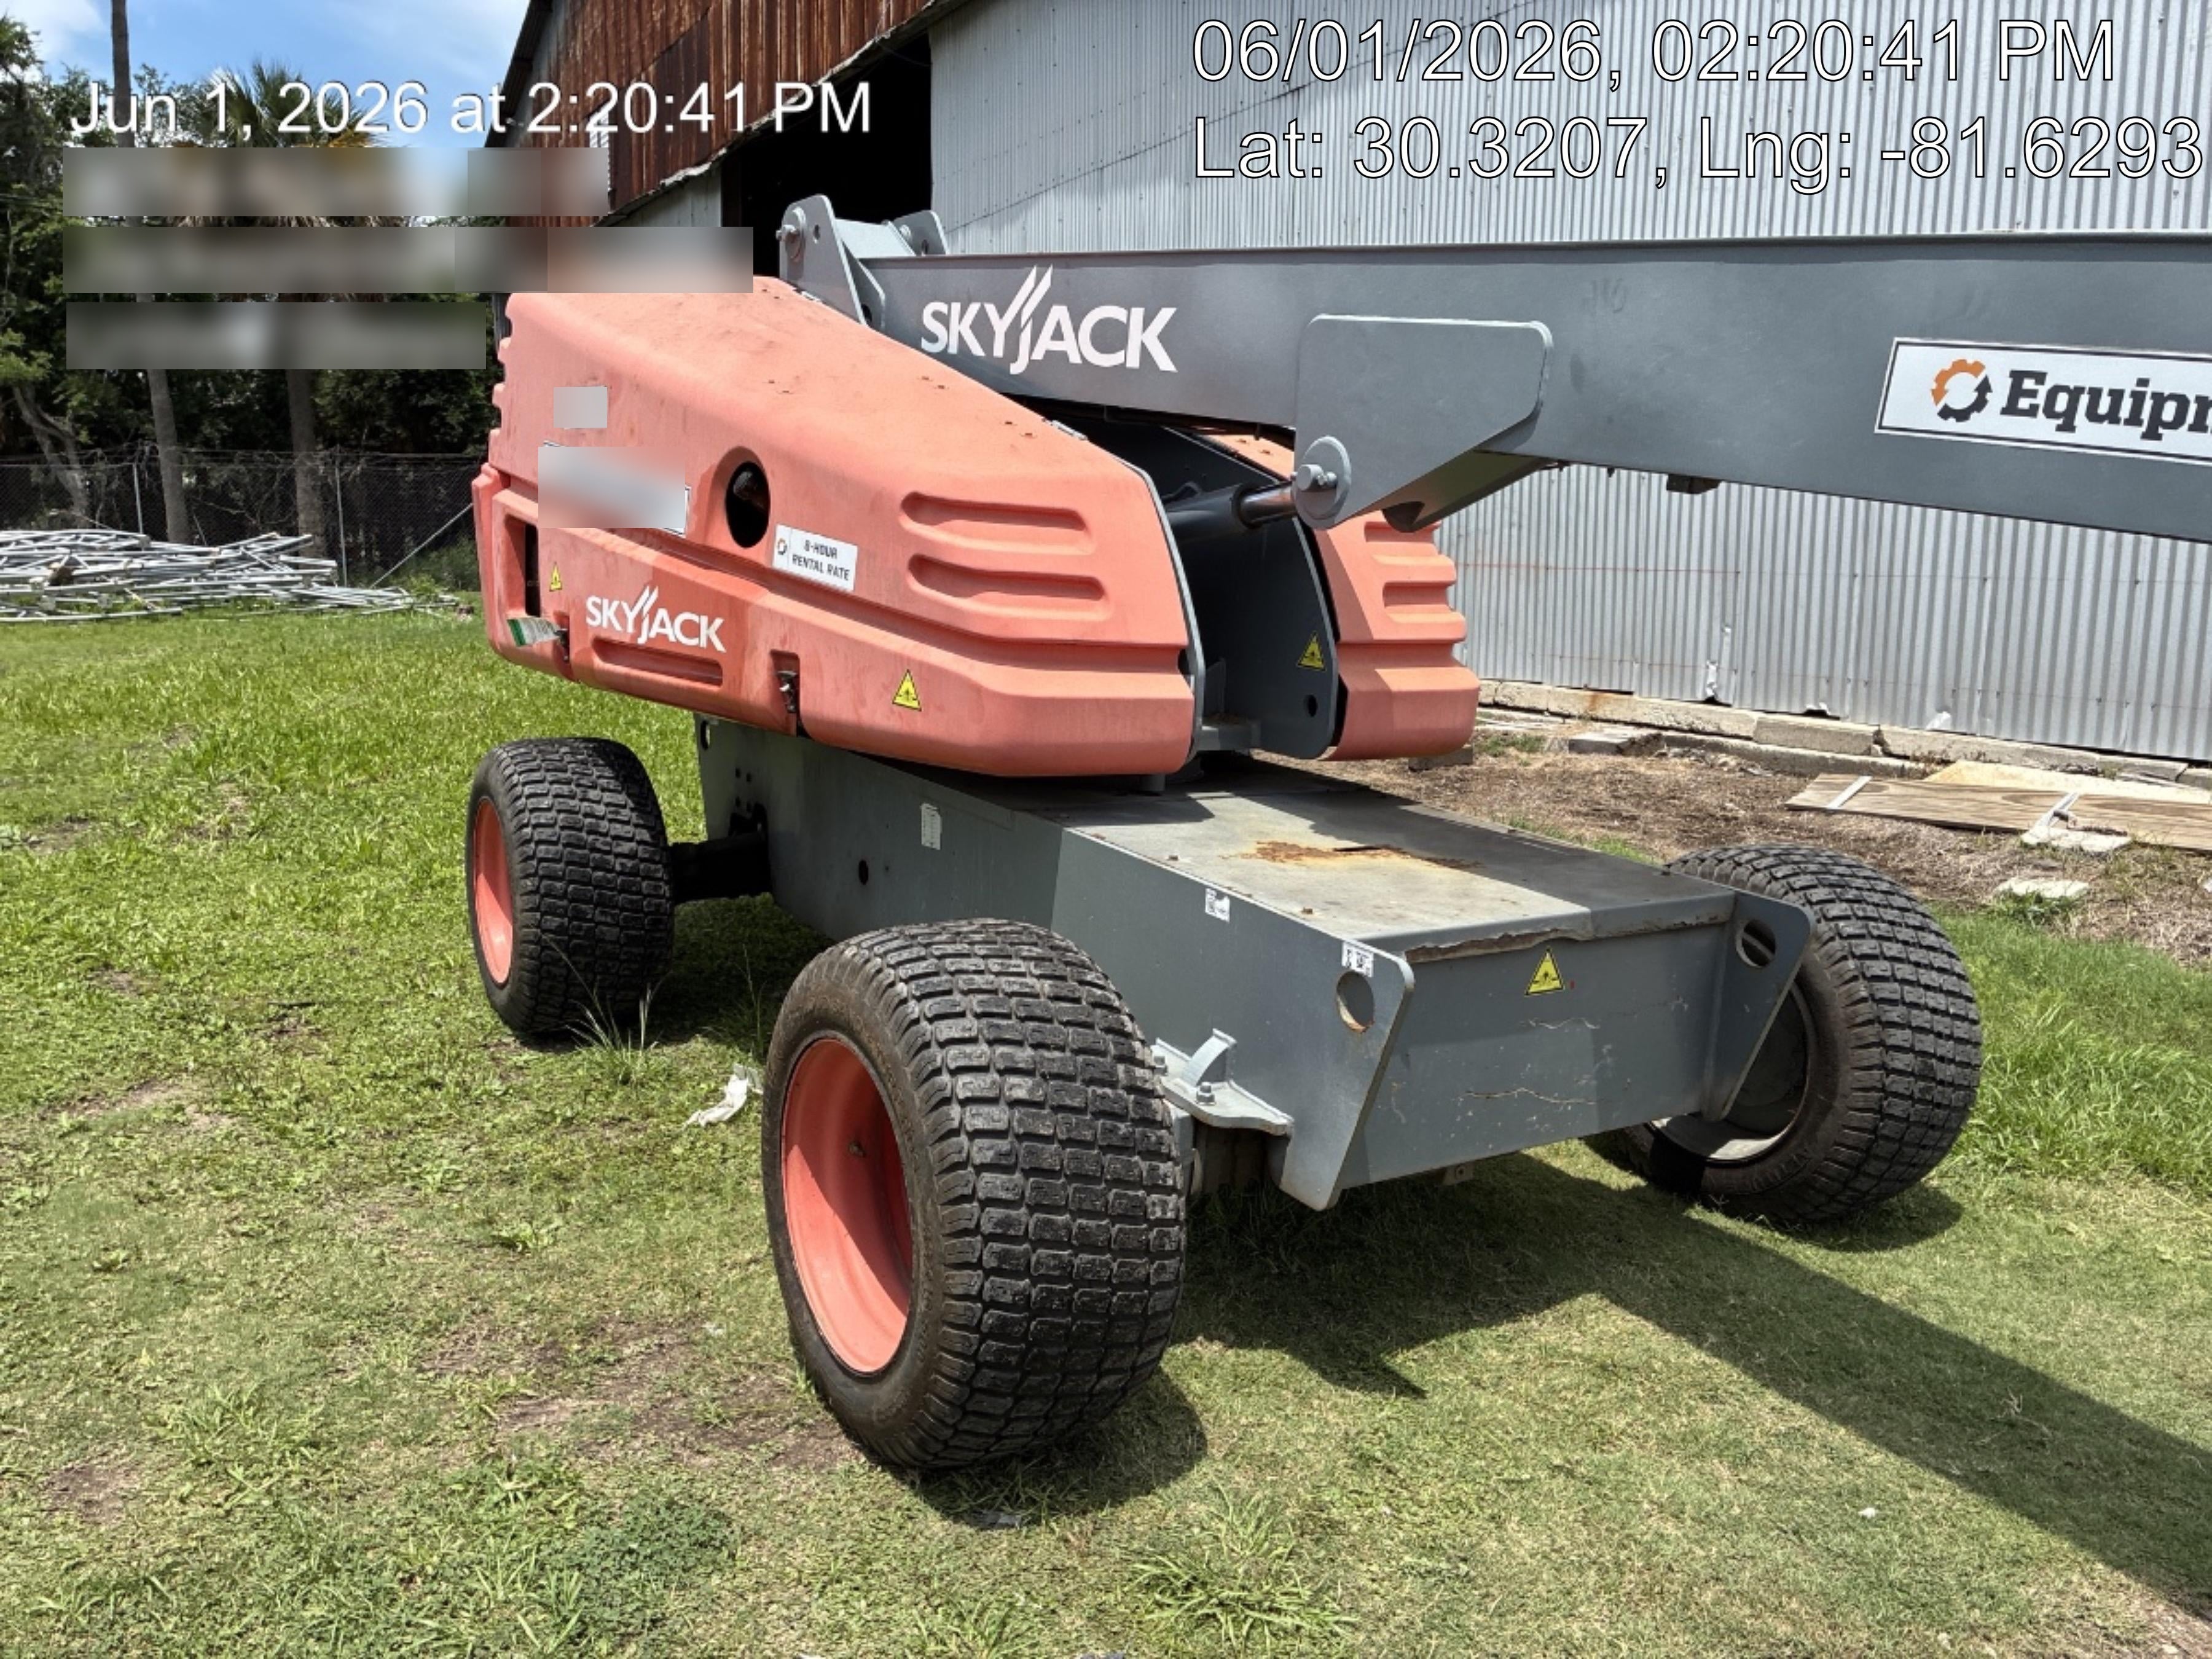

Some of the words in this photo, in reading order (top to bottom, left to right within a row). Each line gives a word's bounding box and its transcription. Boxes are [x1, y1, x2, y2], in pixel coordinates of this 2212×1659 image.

[920, 264, 1179, 375] SKYJACK
[792, 554, 824, 574] RENTAL
[827, 564, 850, 581] RATE
[585, 585, 726, 653] SKYJACK
